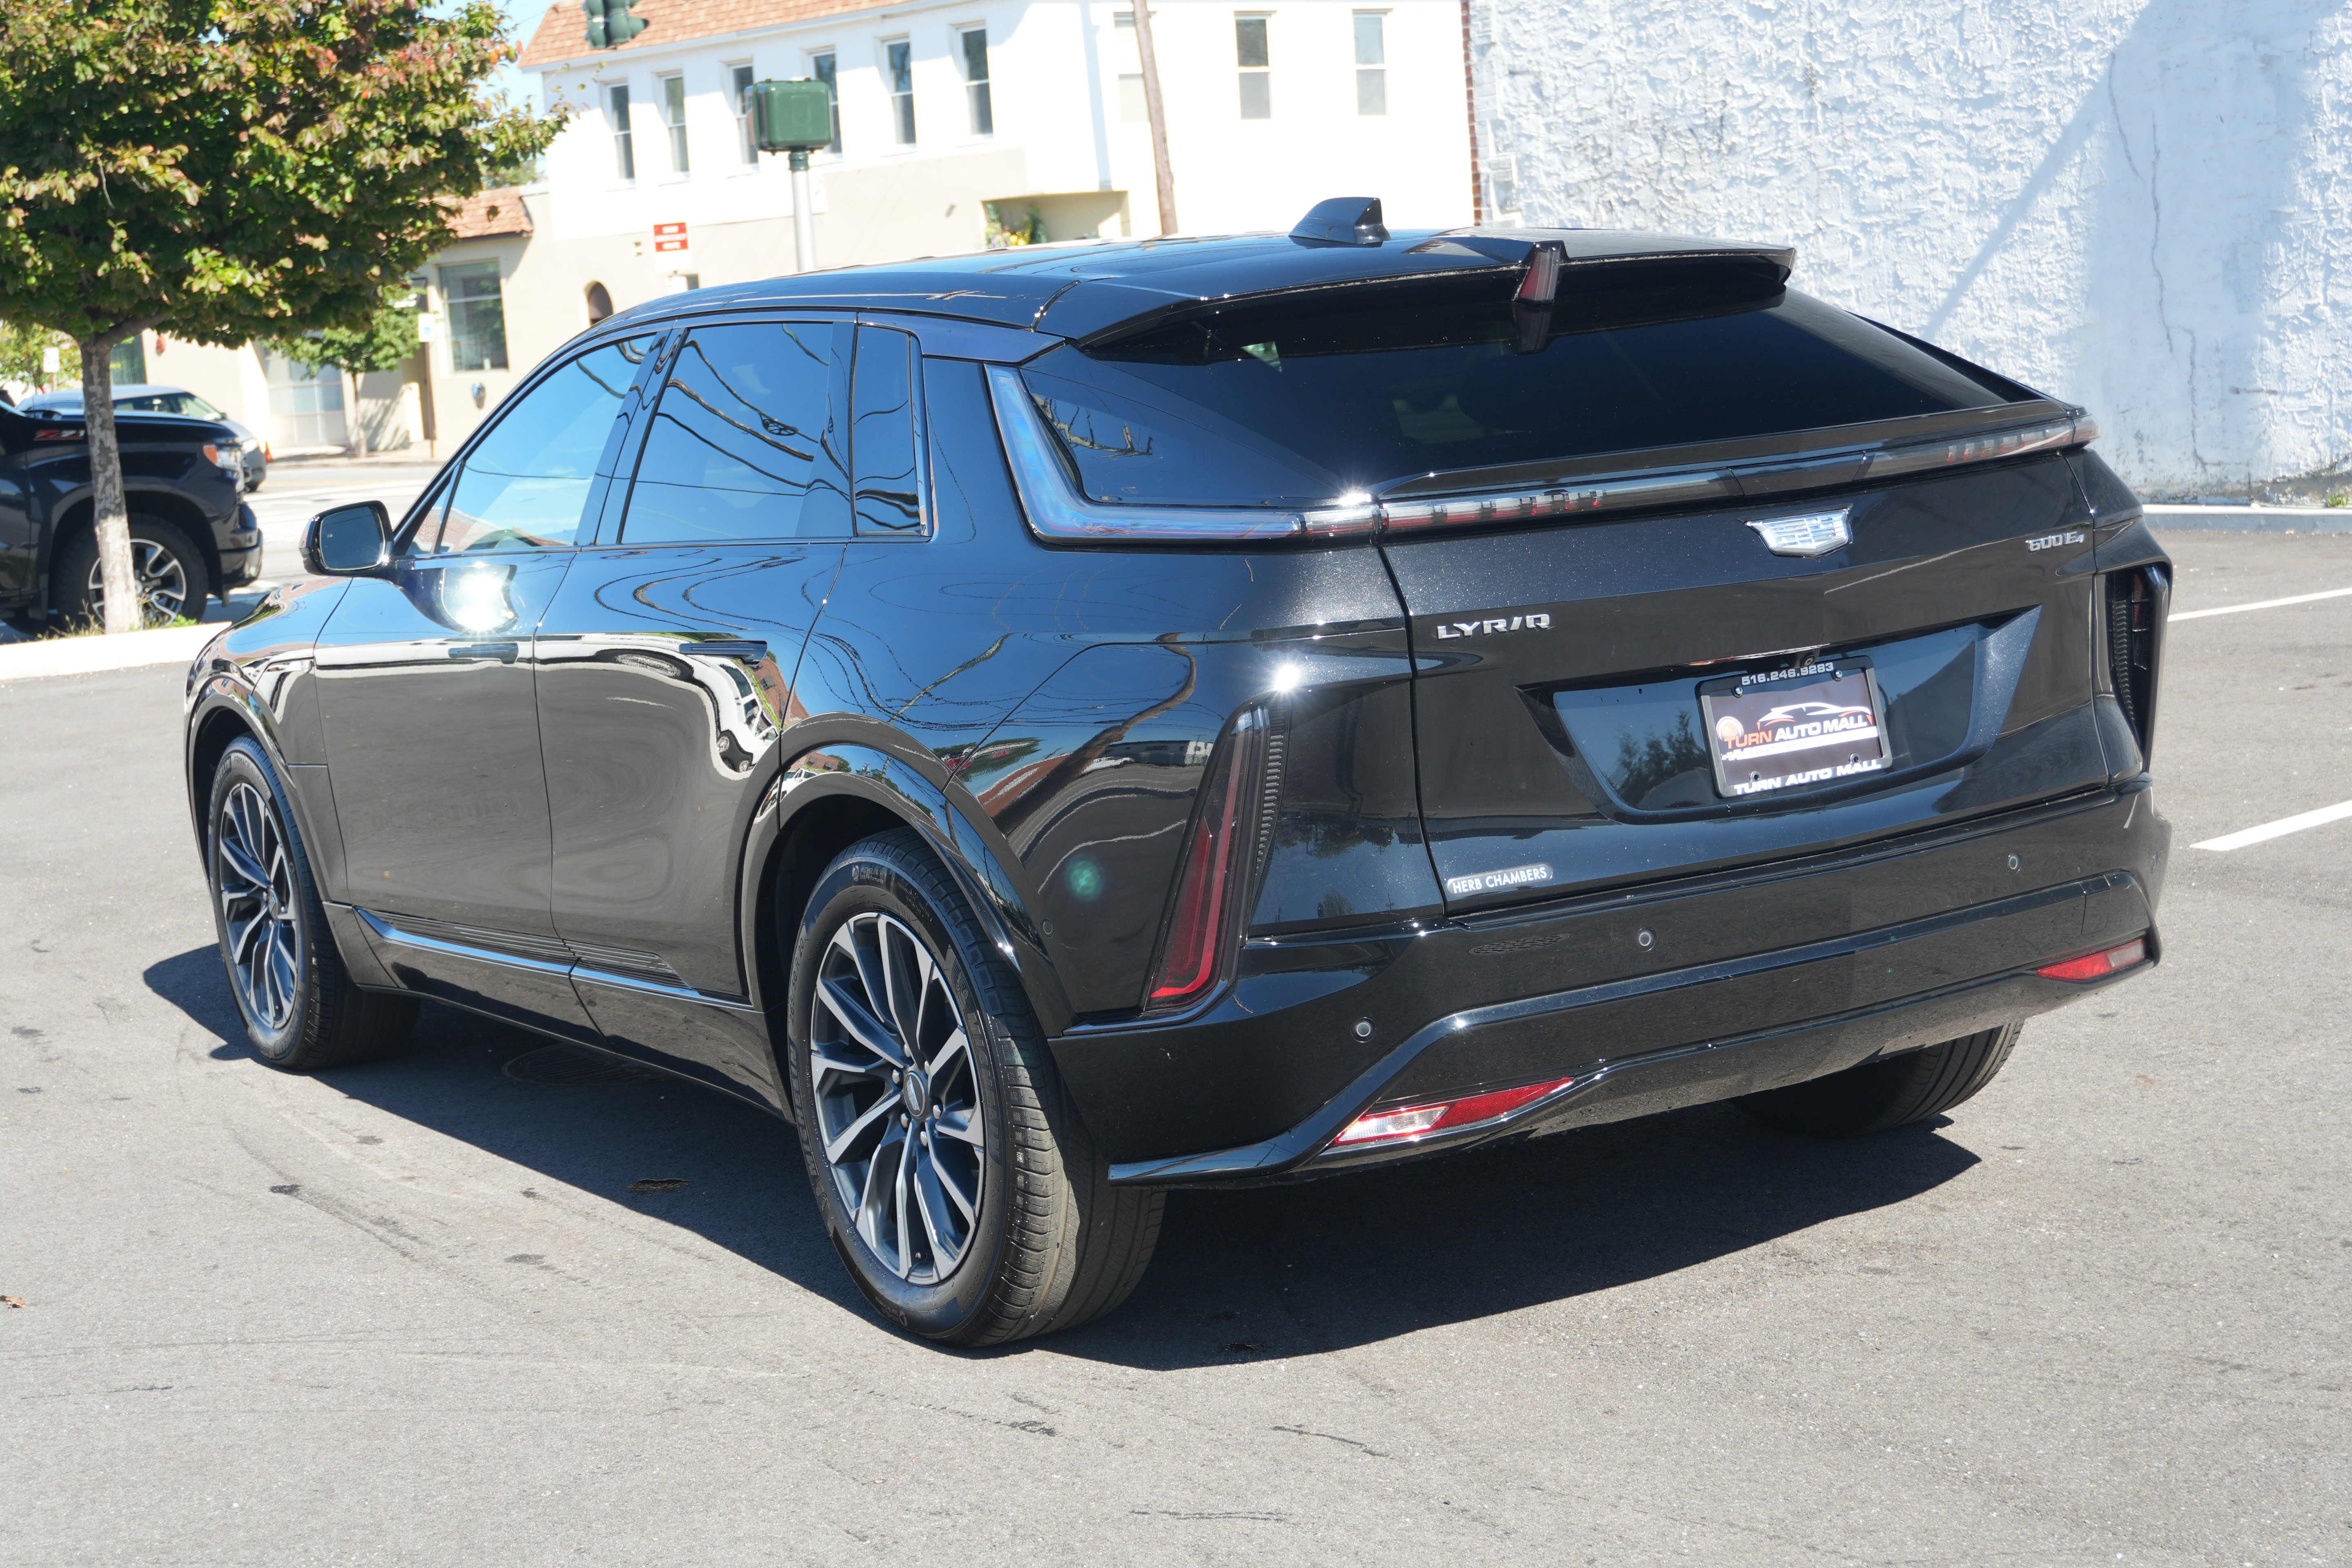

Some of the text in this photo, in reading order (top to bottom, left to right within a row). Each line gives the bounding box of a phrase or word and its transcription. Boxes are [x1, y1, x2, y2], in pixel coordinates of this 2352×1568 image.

[1741, 662, 1834, 686] 516.246.9283
[1724, 730, 1772, 749] TURN
[1774, 721, 1821, 742] AUTO
[1823, 714, 1867, 733] MALL
[234, 756, 250, 768] PRIMACY
[1734, 758, 1881, 795] TURN AUTO MALL
[1452, 866, 1548, 894] HERB CHAMBERS
[967, 1012, 1000, 1158] MICHELIN
